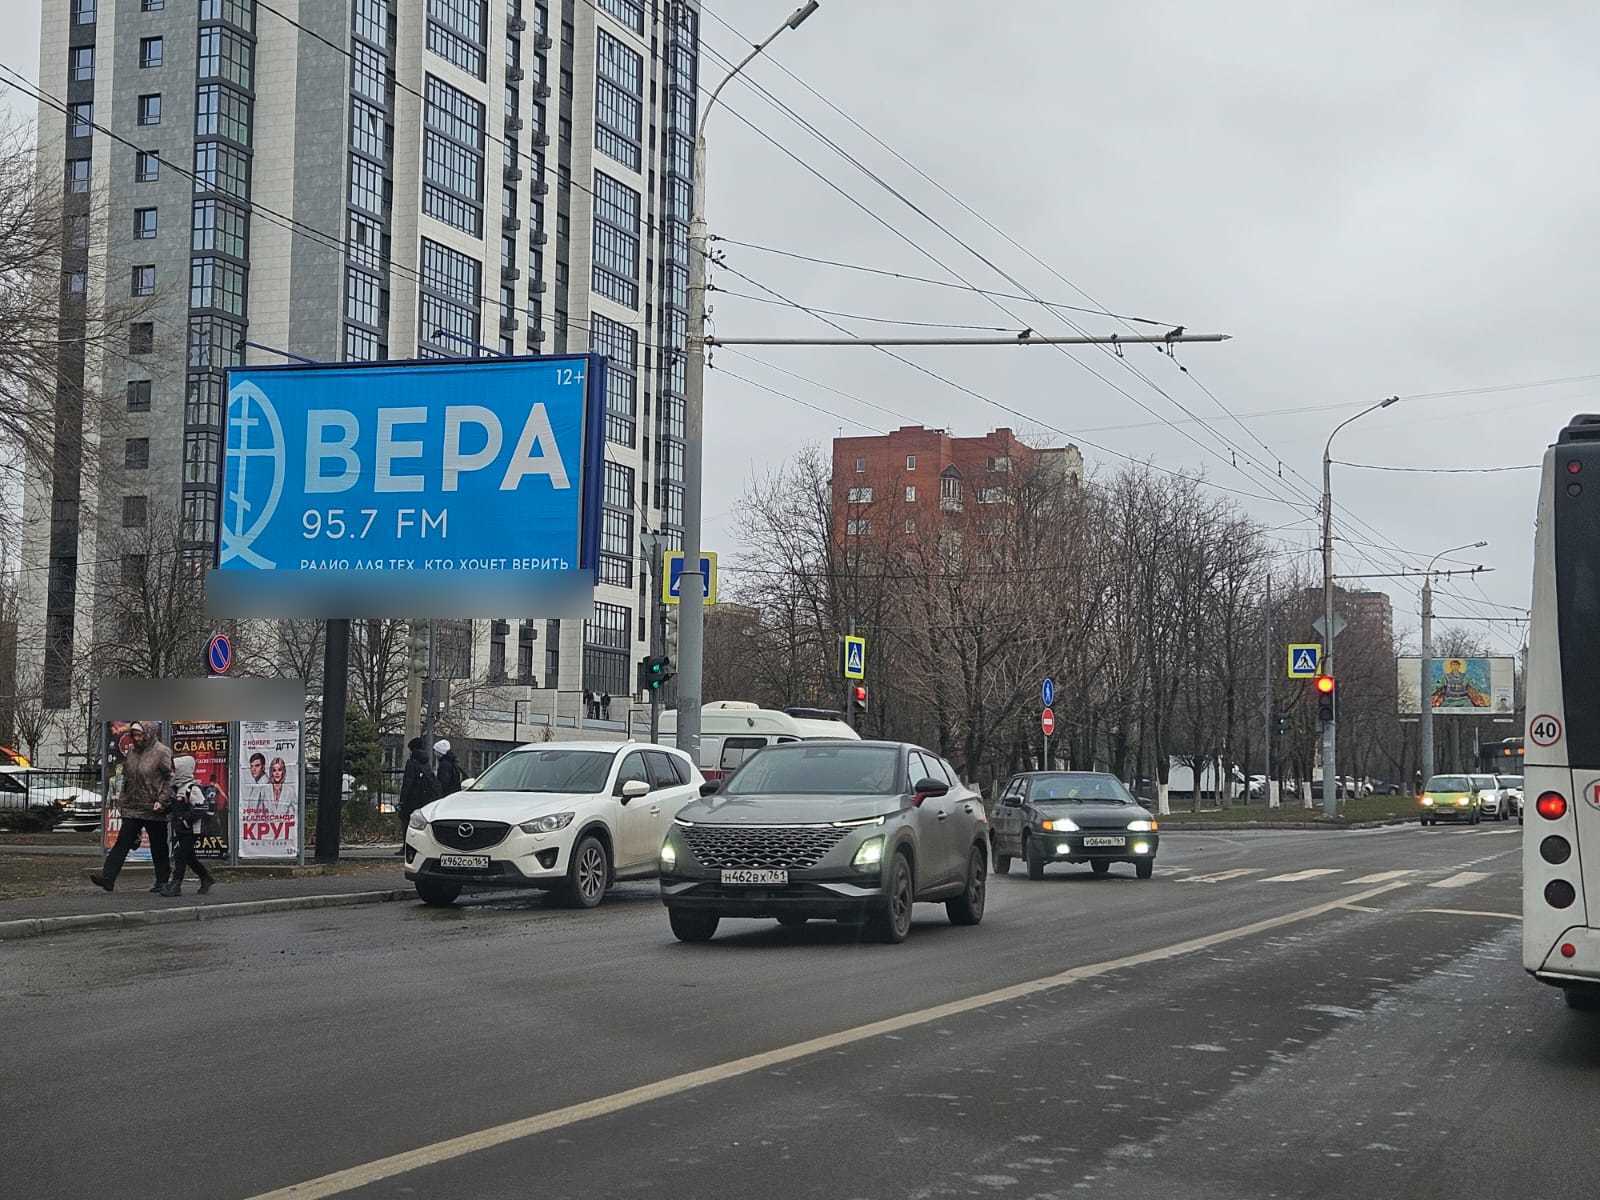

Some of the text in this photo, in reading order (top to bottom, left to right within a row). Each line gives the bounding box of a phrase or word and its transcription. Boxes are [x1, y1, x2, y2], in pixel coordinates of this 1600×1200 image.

[556, 368, 585, 386] 12+
[304, 402, 571, 493] ВЕРА
[302, 508, 448, 540] 95.7 FM
[425, 559, 454, 570] КТО
[459, 558, 508, 570] ХОЧЕТ
[512, 557, 569, 570] ВЕРИТЬ
[1534, 722, 1556, 738] 40
[173, 739, 228, 752] CABARET
[275, 743, 296, 751] ДГТУ
[243, 821, 295, 840] КРУГ
[724, 870, 785, 882] Н462ВХ 761
